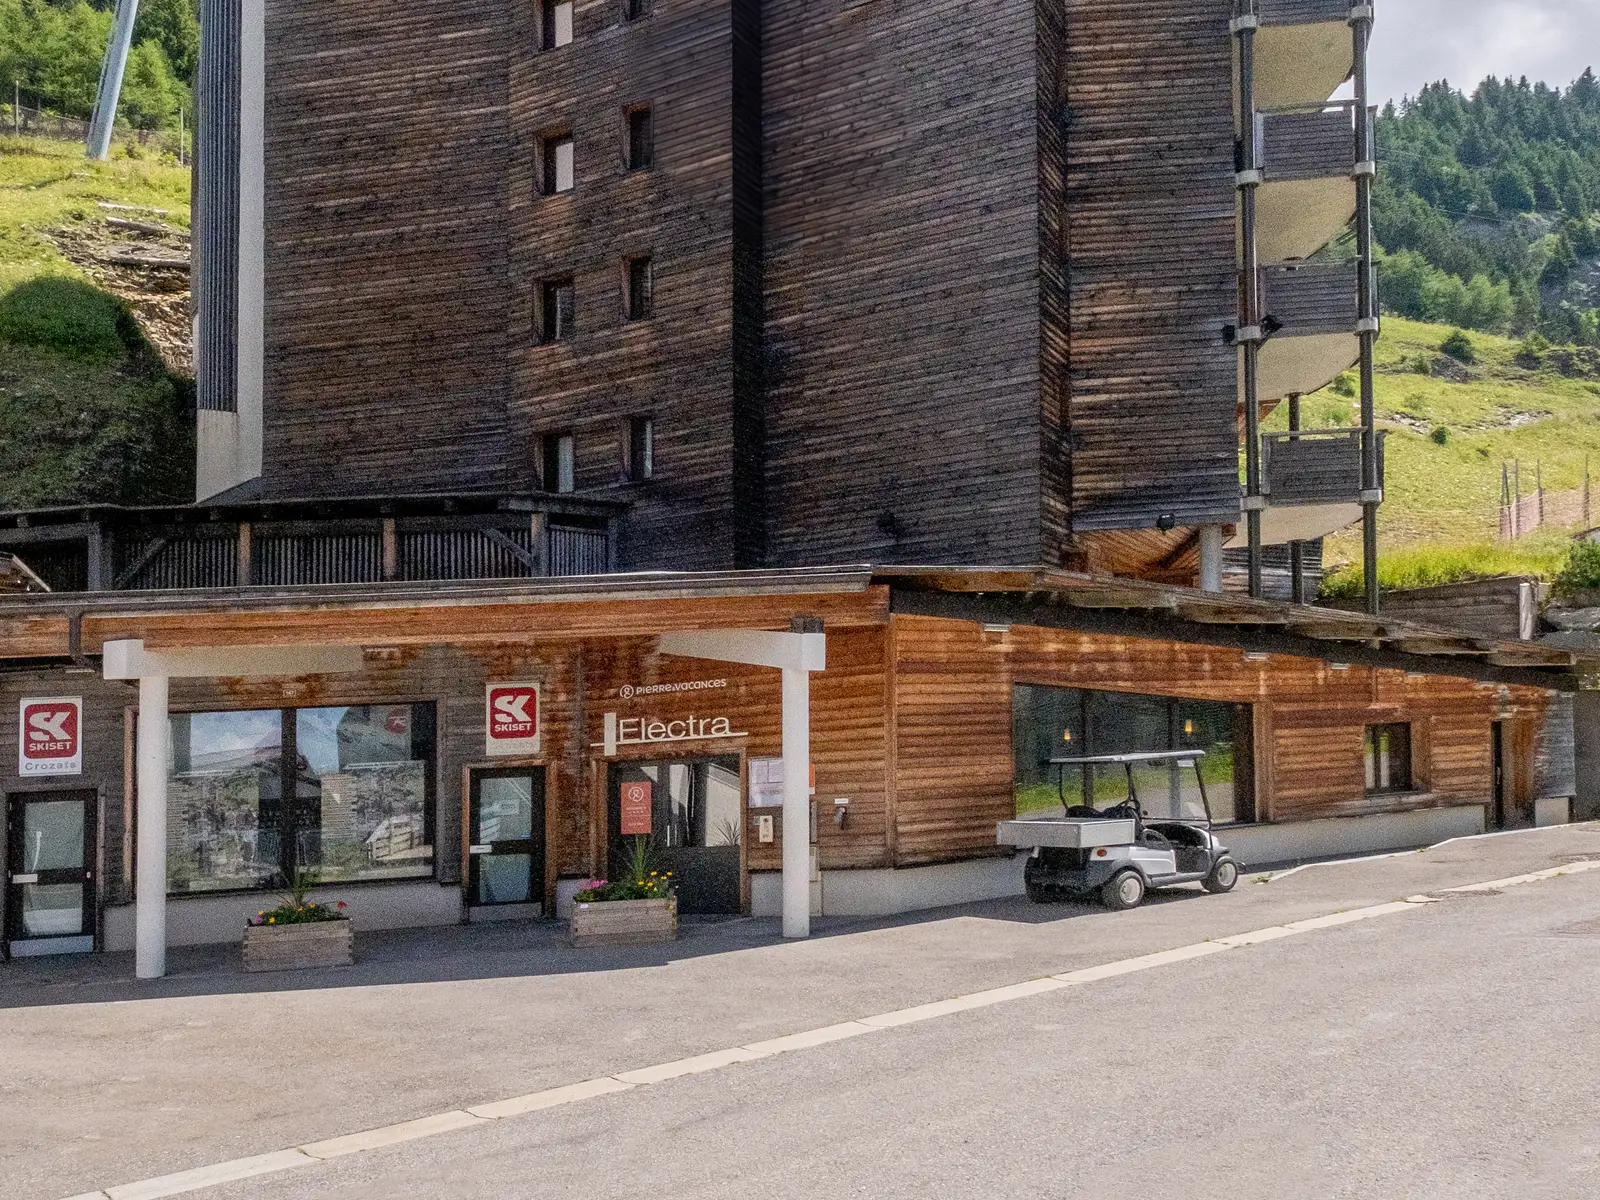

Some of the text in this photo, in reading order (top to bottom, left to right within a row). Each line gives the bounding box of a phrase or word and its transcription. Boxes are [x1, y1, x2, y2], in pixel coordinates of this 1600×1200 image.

[494, 723, 532, 732] SKISET
[619, 715, 732, 743] Electra
[29, 741, 72, 751] SKISET
